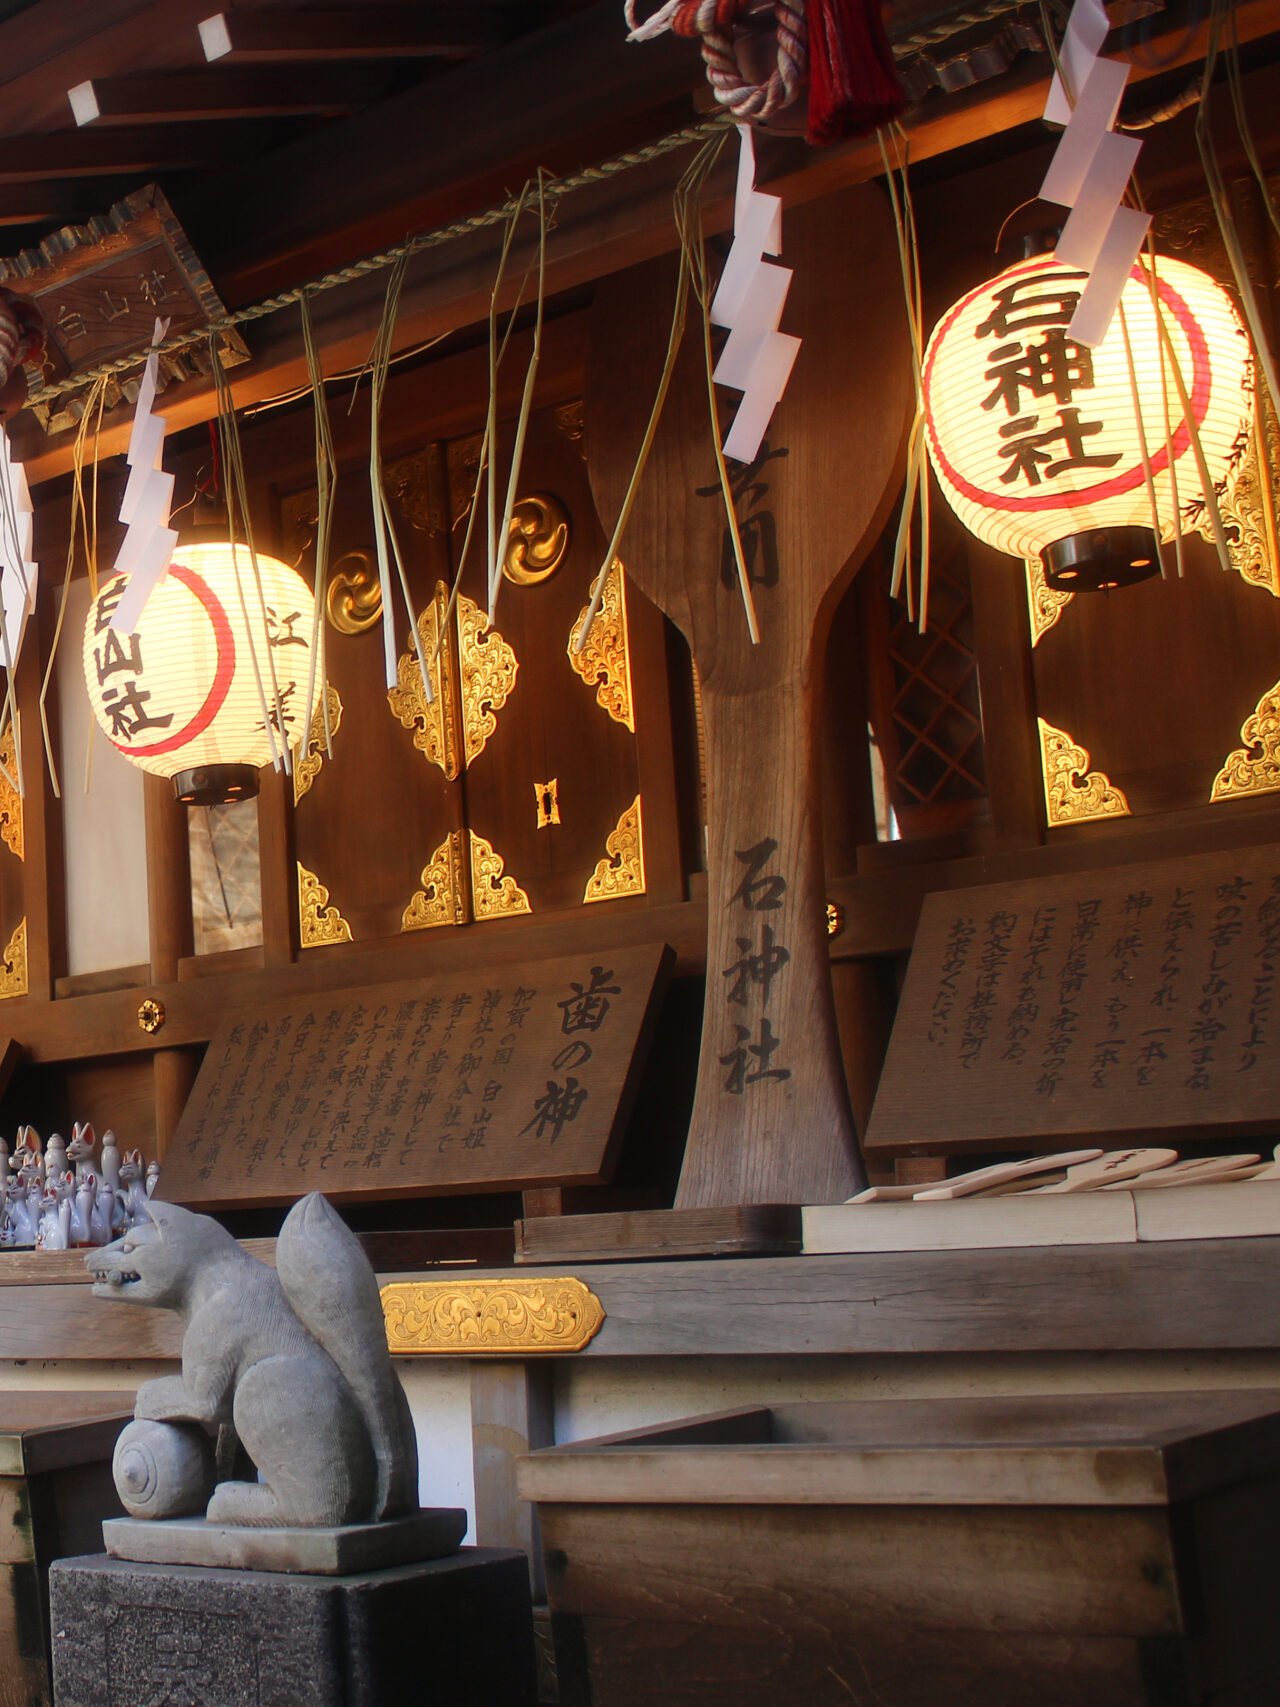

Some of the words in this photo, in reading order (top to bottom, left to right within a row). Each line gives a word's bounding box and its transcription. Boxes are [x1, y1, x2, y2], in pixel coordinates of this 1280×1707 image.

[57, 269, 181, 344] 白山社
[975, 271, 1124, 486] 石神社
[720, 836, 791, 1095] 石神社
[397, 992, 472, 1166] 昔より歯の神として
[437, 988, 505, 1153] 神社の御分社で
[461, 986, 537, 1151] 加賀の国、白山姫
[518, 966, 622, 1144] 歯の神
